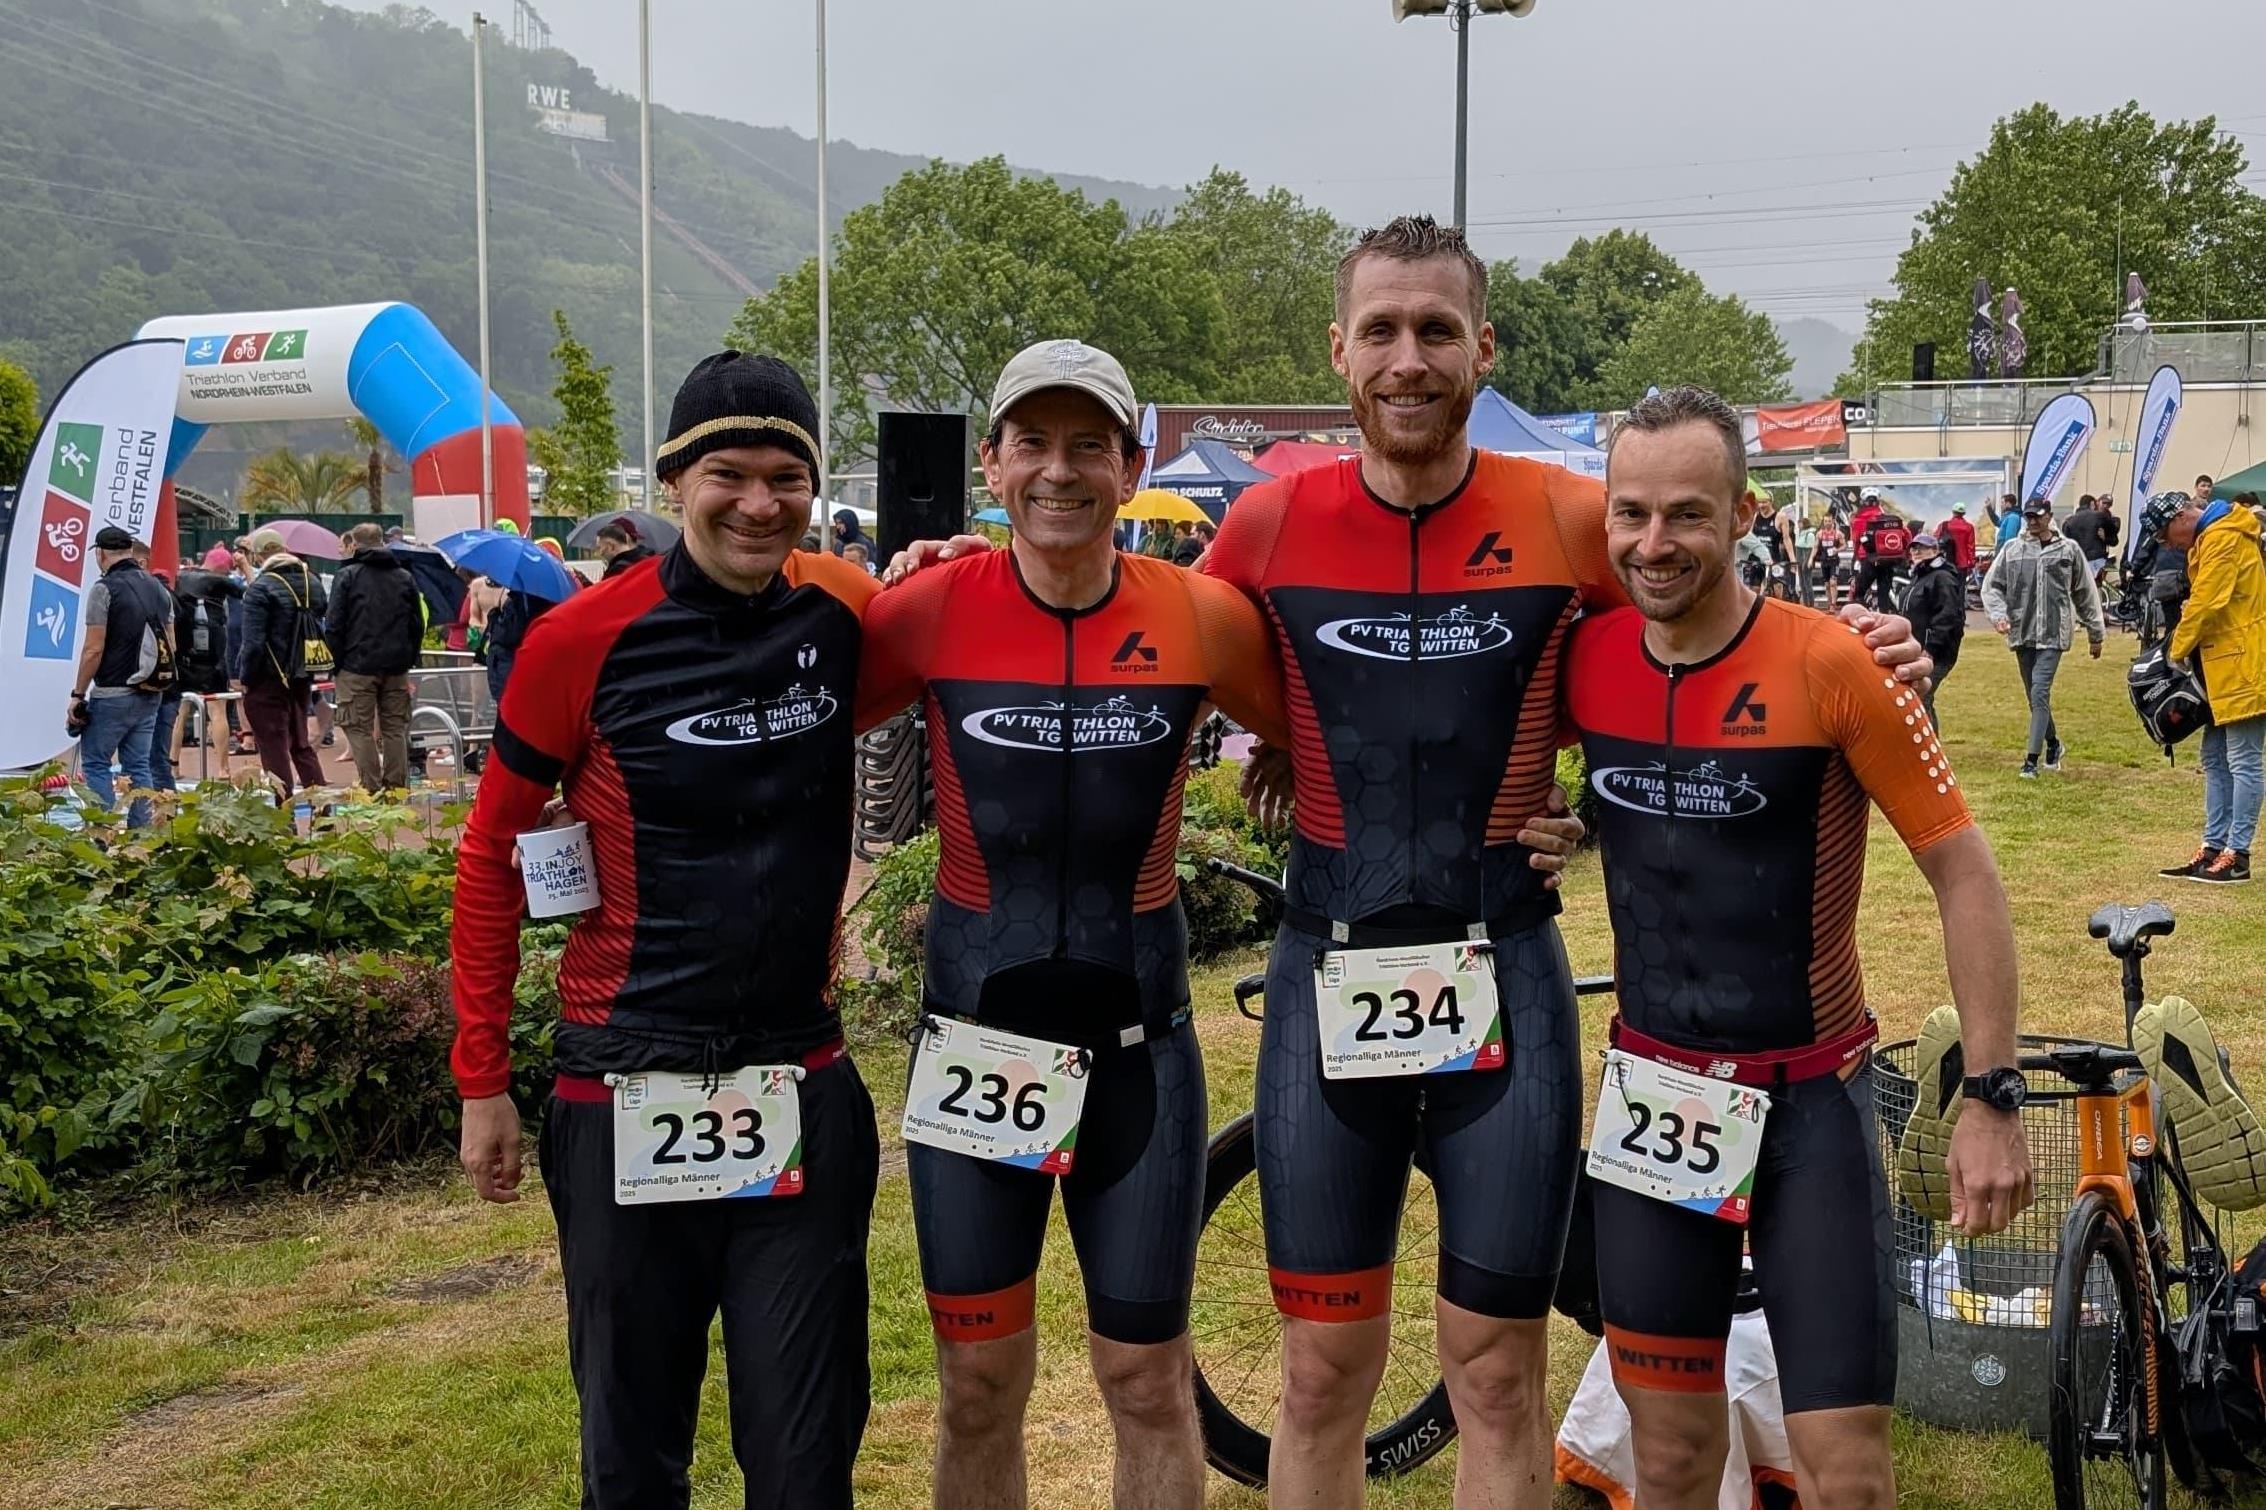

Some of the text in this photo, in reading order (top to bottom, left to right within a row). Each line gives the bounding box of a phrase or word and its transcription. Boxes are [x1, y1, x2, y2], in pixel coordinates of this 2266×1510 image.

[527, 83, 571, 110] RWE
[185, 368, 307, 386] Triathlon Verband
[190, 383, 313, 399] NORDRHEIN-WESTFALEN
[2142, 409, 2173, 483] Sparda-Bank
[2036, 430, 2079, 497] Sparda-Bank
[1181, 487, 1224, 498] SCHULTZ
[1463, 565, 1513, 578] surpas
[1350, 624, 1373, 637] PV
[1389, 637, 1480, 653] TG WITTEN
[1110, 663, 1159, 674] surpas
[701, 715, 722, 730] PV
[737, 711, 818, 737] TG WITTEN
[992, 713, 1018, 727] PV
[1036, 729, 1142, 744] TG WITTEN
[1720, 725, 1767, 738] surpas
[1612, 773, 1632, 788] PV
[1647, 792, 1732, 815] TG WITTEN
[545, 855, 582, 871] INJOY
[545, 875, 588, 892] HAGEN
[1351, 985, 1466, 1043] 234
[1326, 1049, 1422, 1063] Regionalliga Männer
[938, 1065, 1048, 1132] 236
[652, 1108, 766, 1165] 233
[907, 1114, 995, 1143] Regionalliga Männer
[2094, 1110, 2103, 1160] ORBEA
[1620, 1101, 1722, 1175] 235
[1591, 1150, 1673, 1184] Regionalliga Männer
[620, 1173, 721, 1188] Regionalliga Männer
[1616, 1345, 1714, 1373] WITTEN
[1380, 1418, 1441, 1471] SWISS
